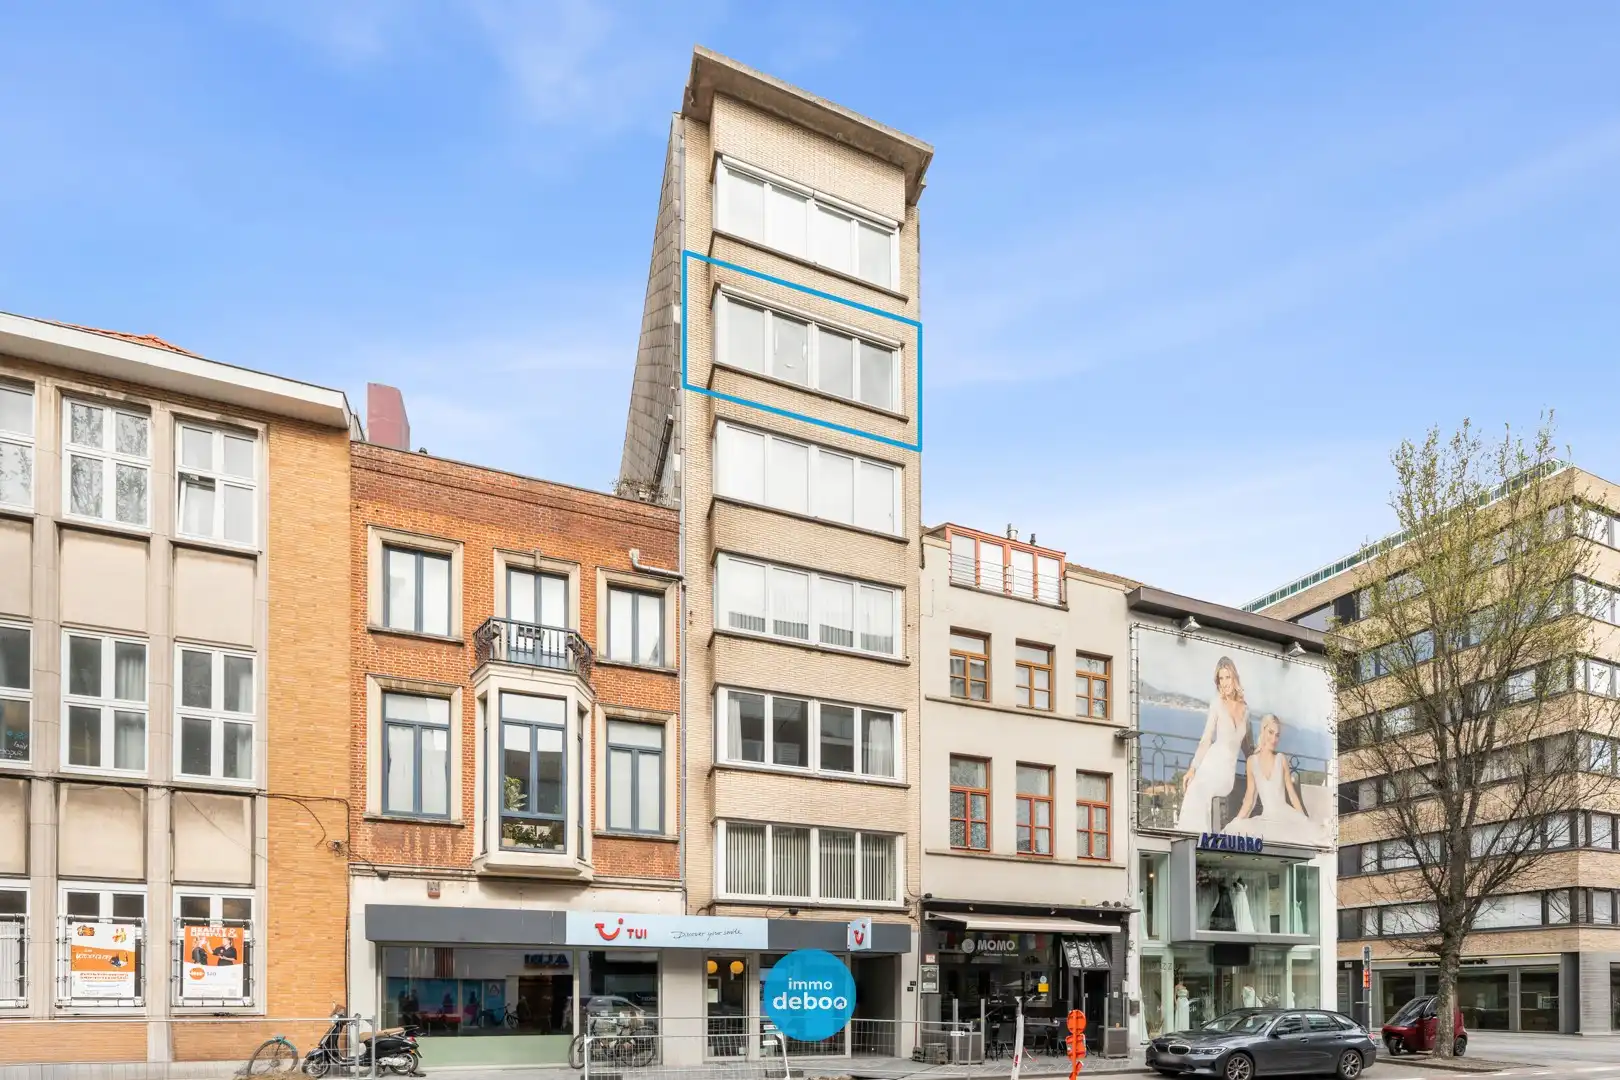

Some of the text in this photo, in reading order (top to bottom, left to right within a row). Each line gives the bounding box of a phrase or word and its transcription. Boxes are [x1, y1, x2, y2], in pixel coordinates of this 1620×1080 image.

[1200, 832, 1264, 853] AZZURRO
[626, 928, 648, 939] TUI
[977, 939, 1016, 951] MOMO
